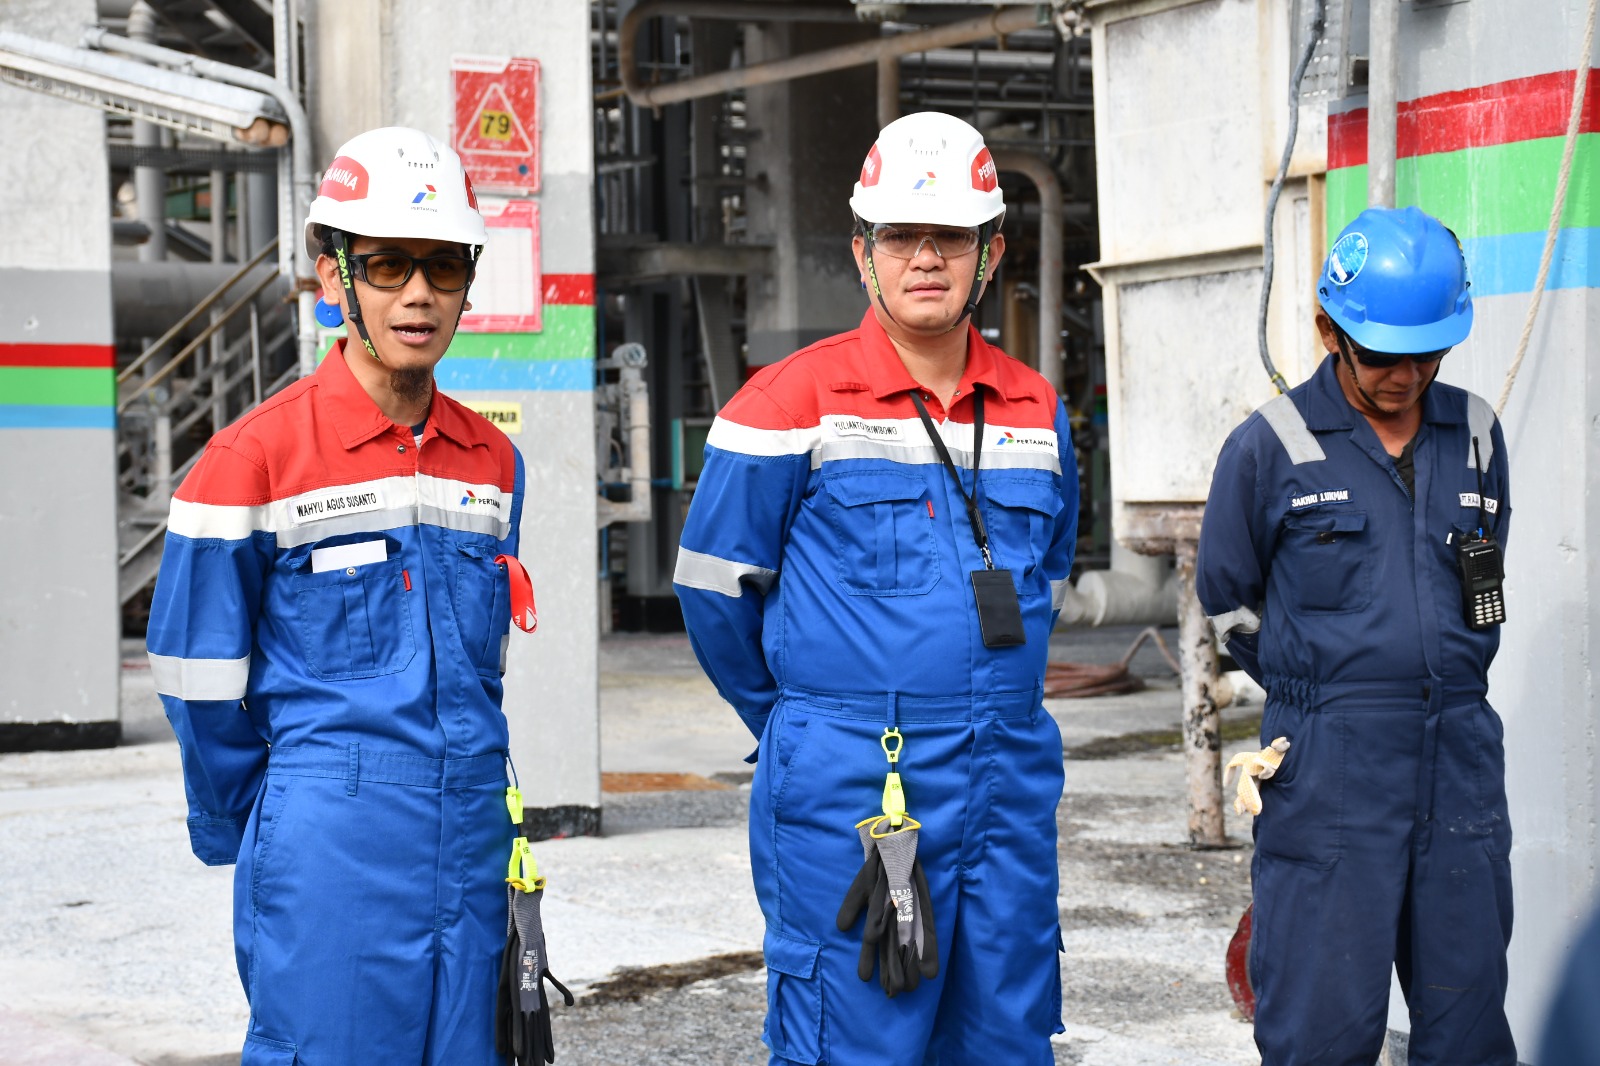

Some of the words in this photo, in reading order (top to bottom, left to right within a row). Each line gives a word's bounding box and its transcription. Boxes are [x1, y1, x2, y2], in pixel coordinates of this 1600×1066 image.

[483, 114, 510, 134] 79
[336, 247, 351, 289] uvex
[978, 243, 990, 281] uvex
[867, 257, 881, 296] uvex
[478, 410, 517, 422] EPAIR
[1016, 438, 1054, 448] PERTAMINA
[296, 500, 324, 518] WAHYU
[326, 496, 346, 512] AGUS
[346, 492, 377, 509] SUSANTO
[1291, 493, 1318, 507] SAKHRI
[1320, 490, 1349, 502] LUKMAN
